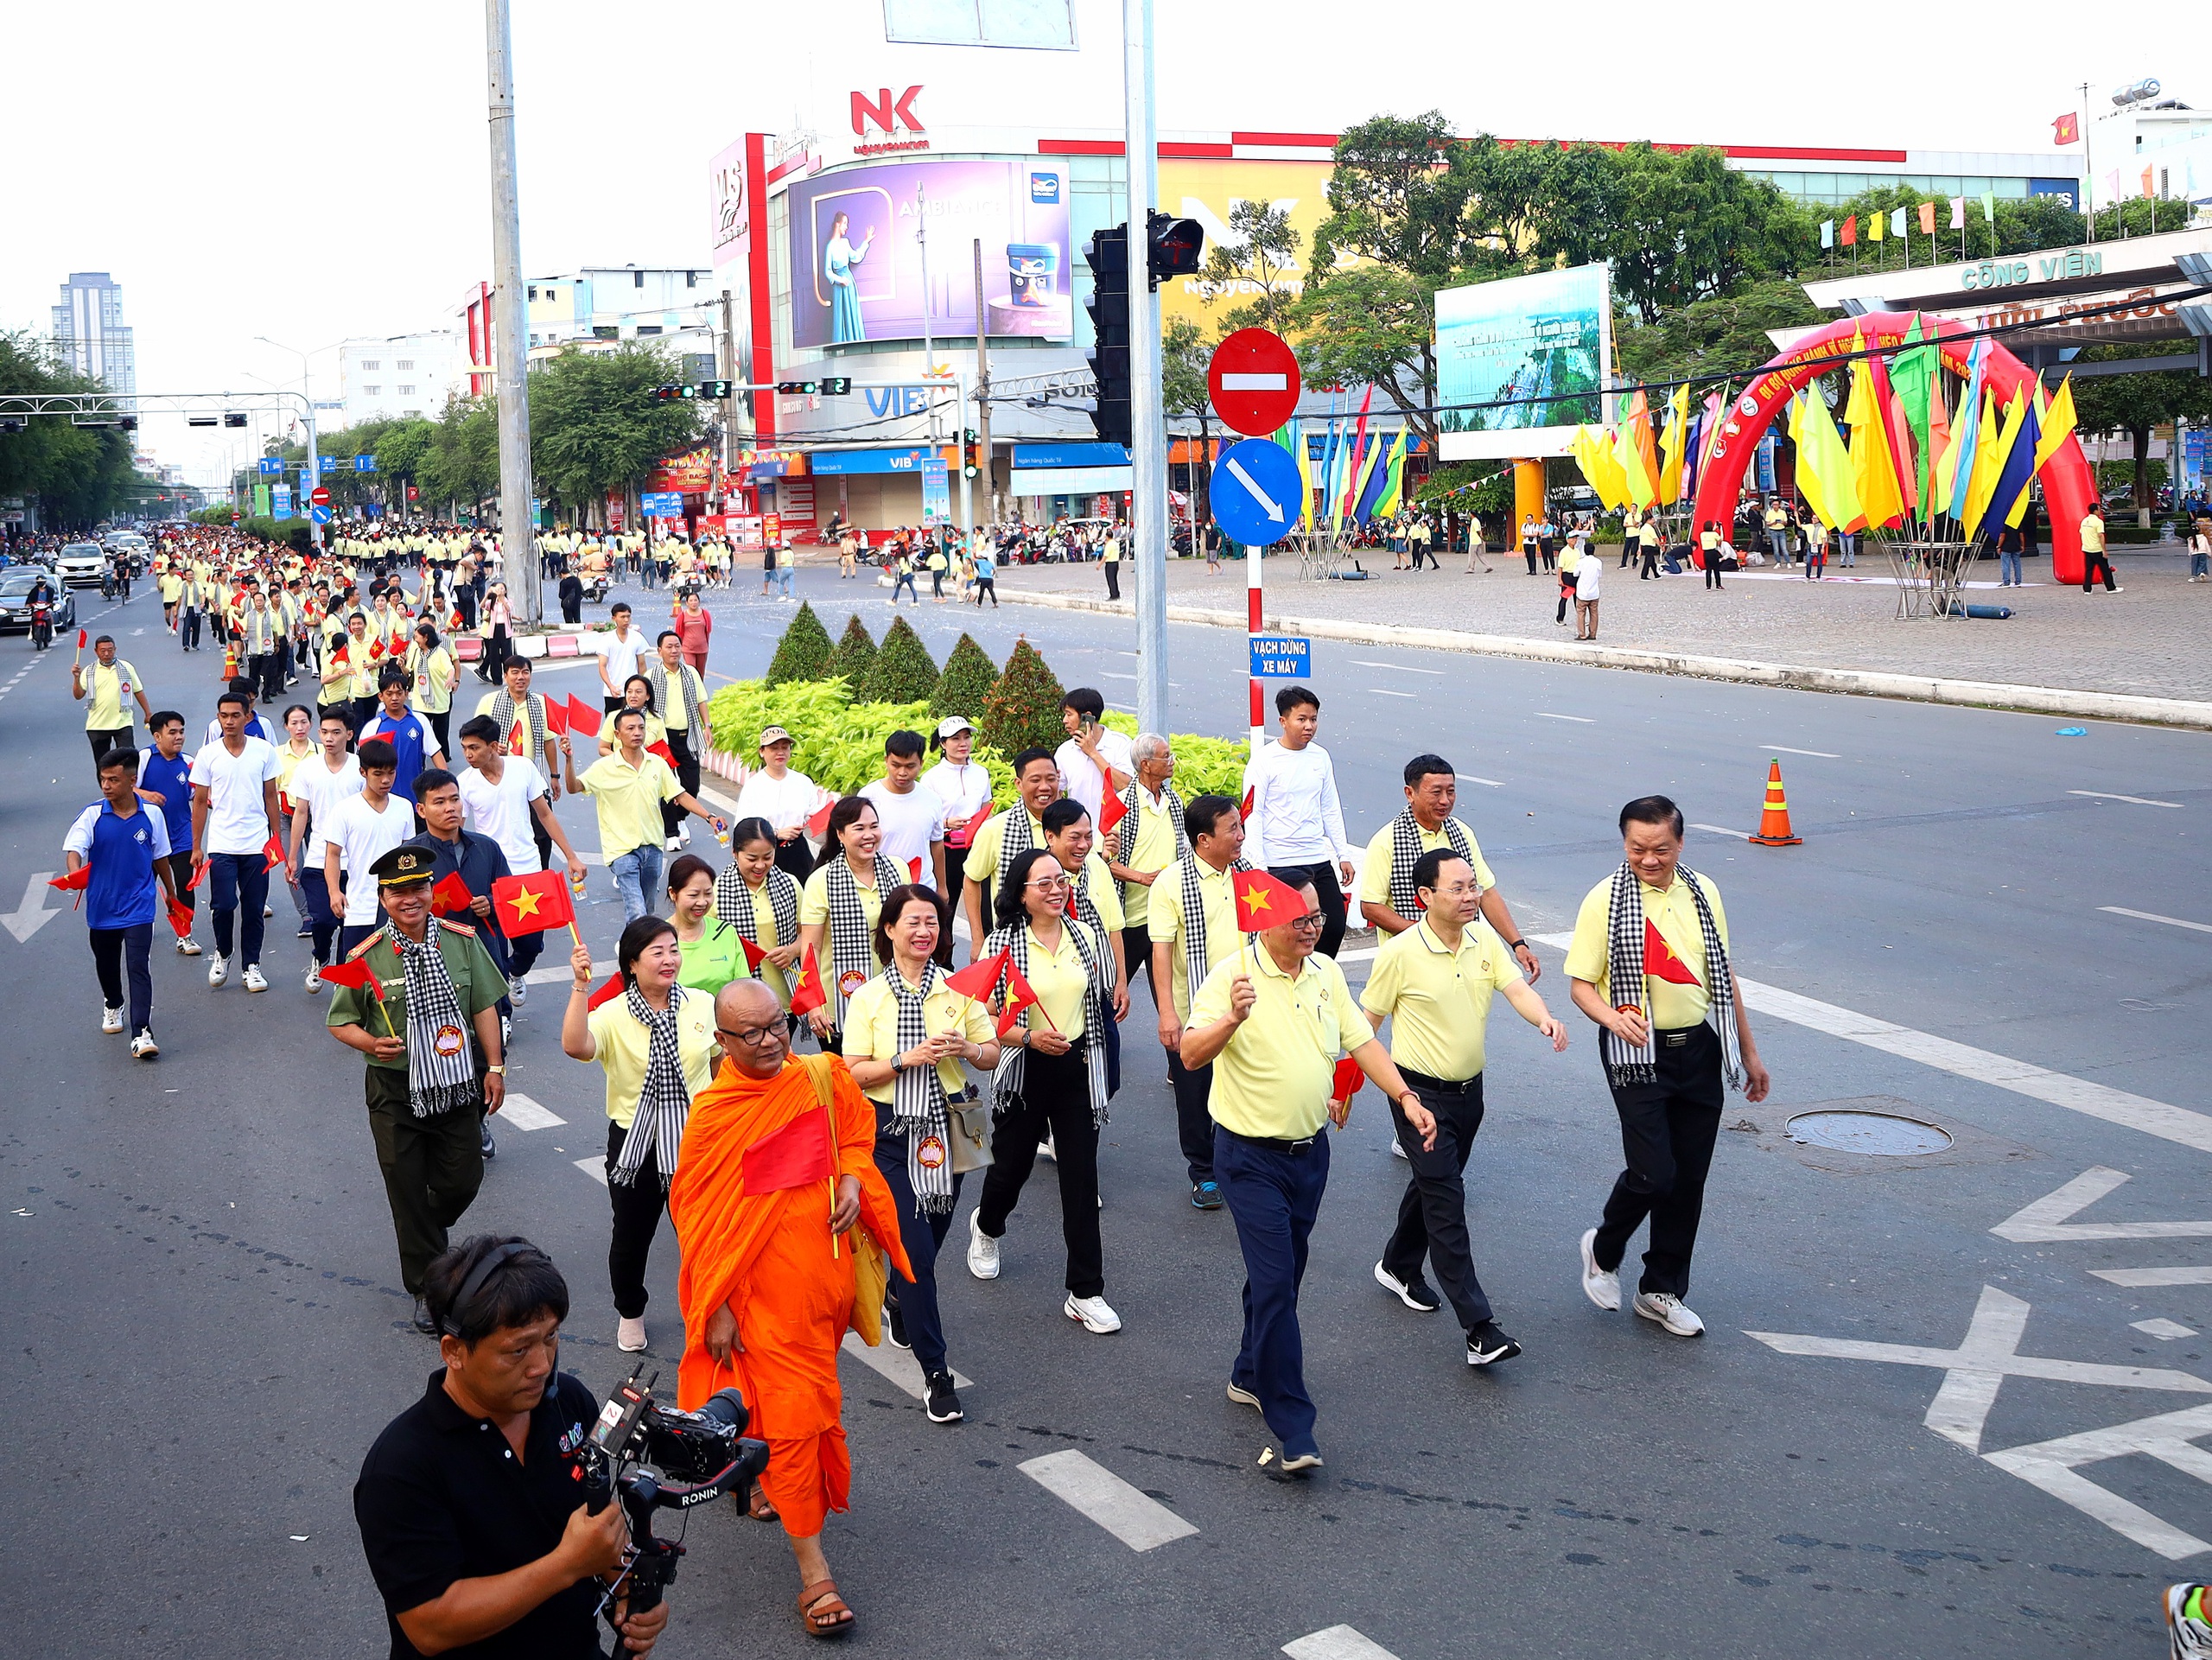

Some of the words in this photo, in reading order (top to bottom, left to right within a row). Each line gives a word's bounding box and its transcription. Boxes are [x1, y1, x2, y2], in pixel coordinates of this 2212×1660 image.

[850, 85, 925, 136] NK
[1961, 261, 2030, 290] CÔNG
[2040, 249, 2102, 282] VIÊN
[865, 386, 929, 418] VIB
[890, 457, 913, 468] VIB
[1253, 640, 1278, 657] VẠCH
[1280, 639, 1306, 655] DỪNG
[1262, 659, 1275, 673] XE
[1276, 658, 1297, 673] MÁY
[682, 1486, 718, 1506] RONIN
